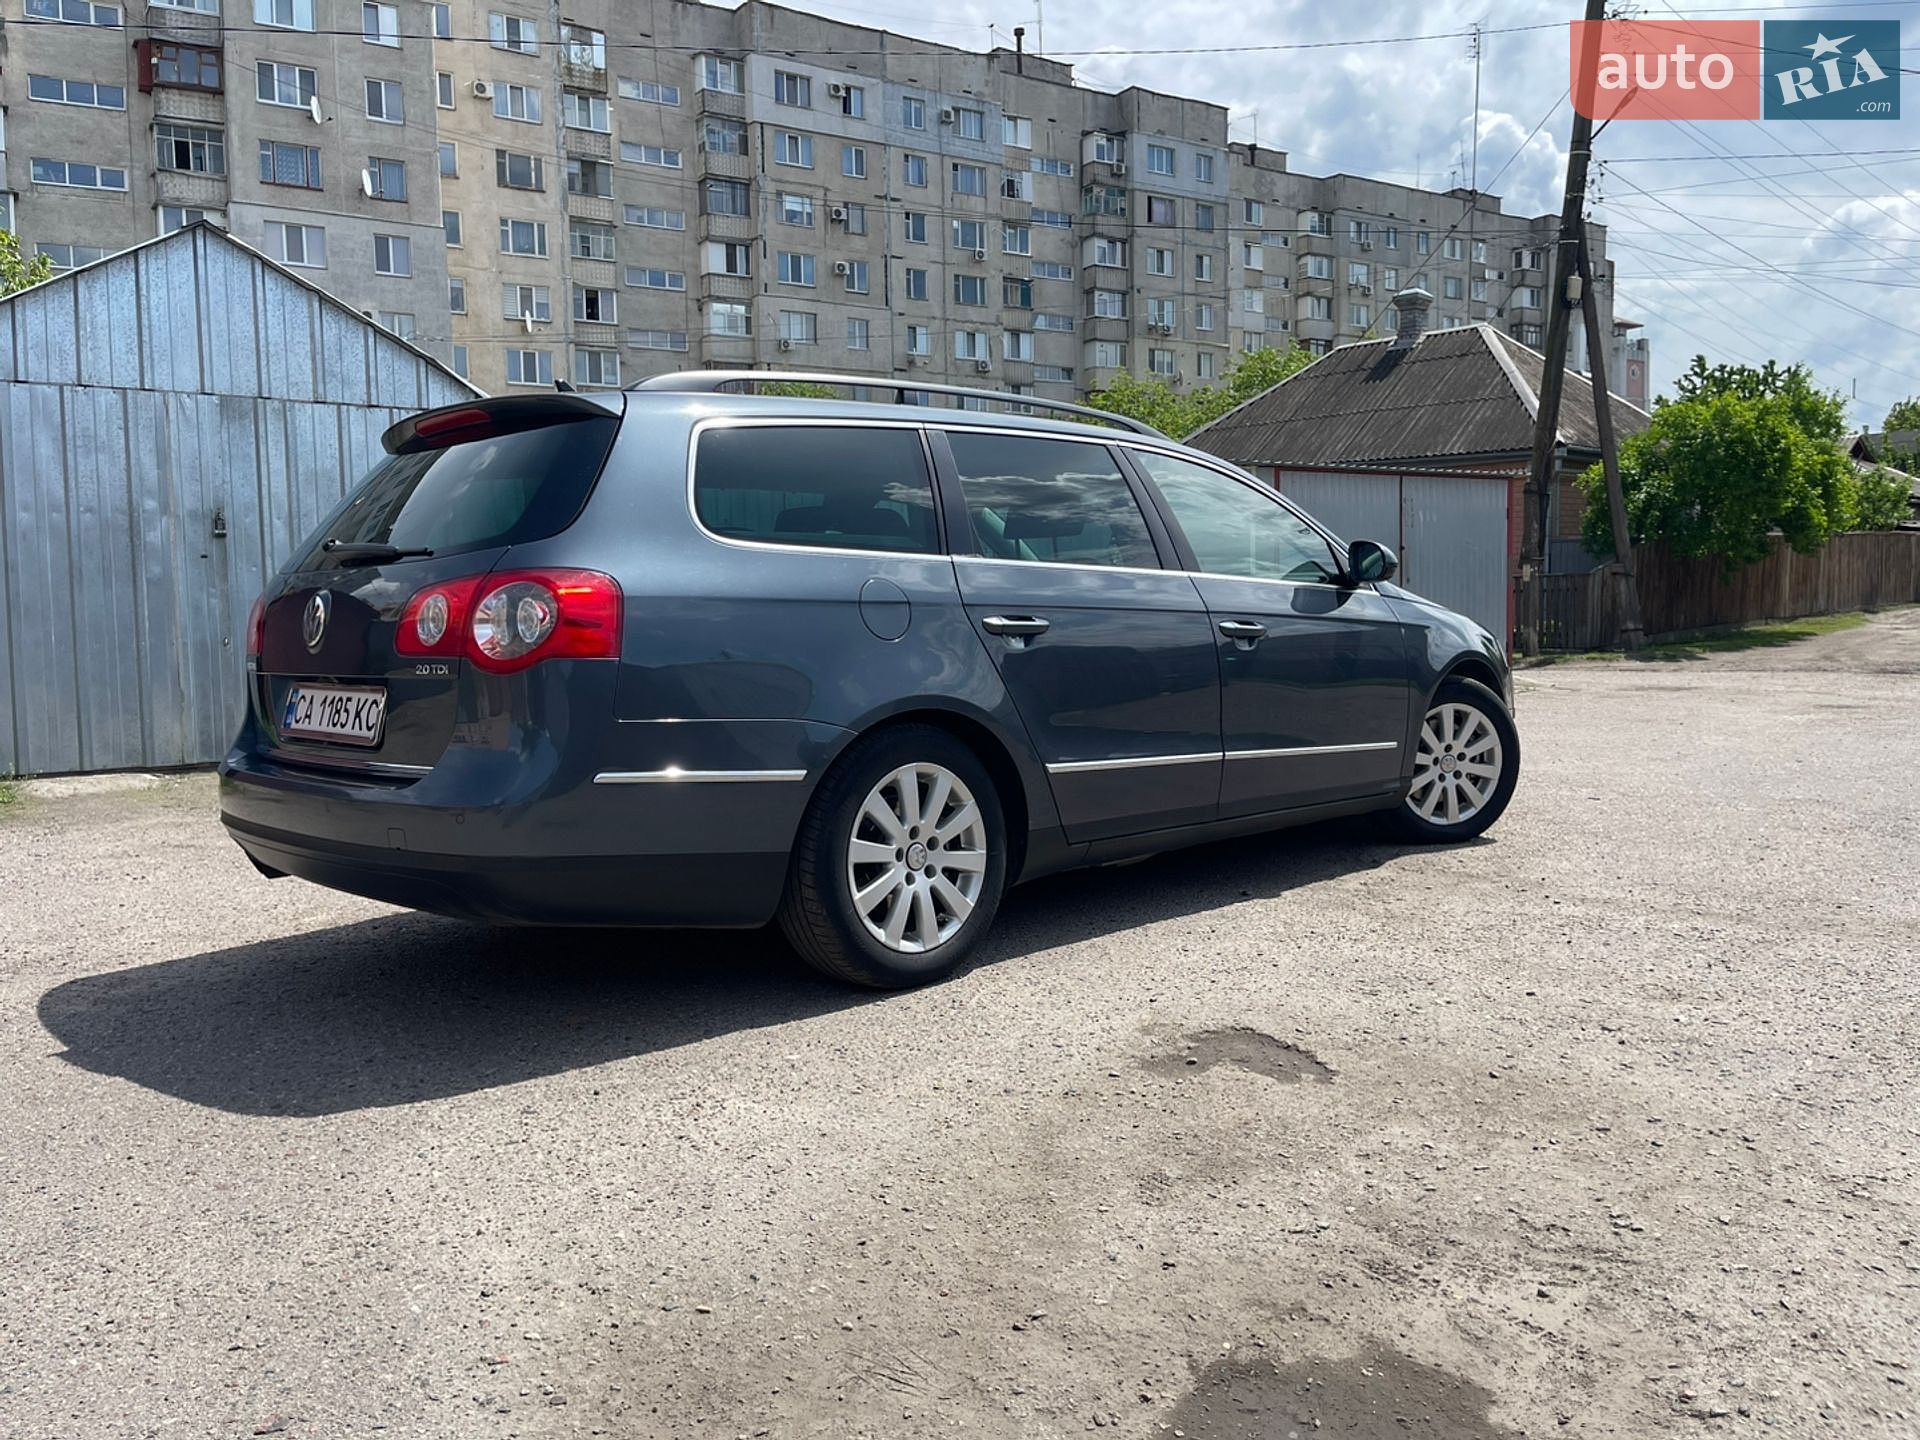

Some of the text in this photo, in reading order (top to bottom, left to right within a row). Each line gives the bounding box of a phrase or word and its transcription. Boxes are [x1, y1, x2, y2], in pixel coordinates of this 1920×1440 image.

[294, 694, 315, 725] CA
[318, 695, 353, 729] 1185
[351, 697, 379, 732] KC
